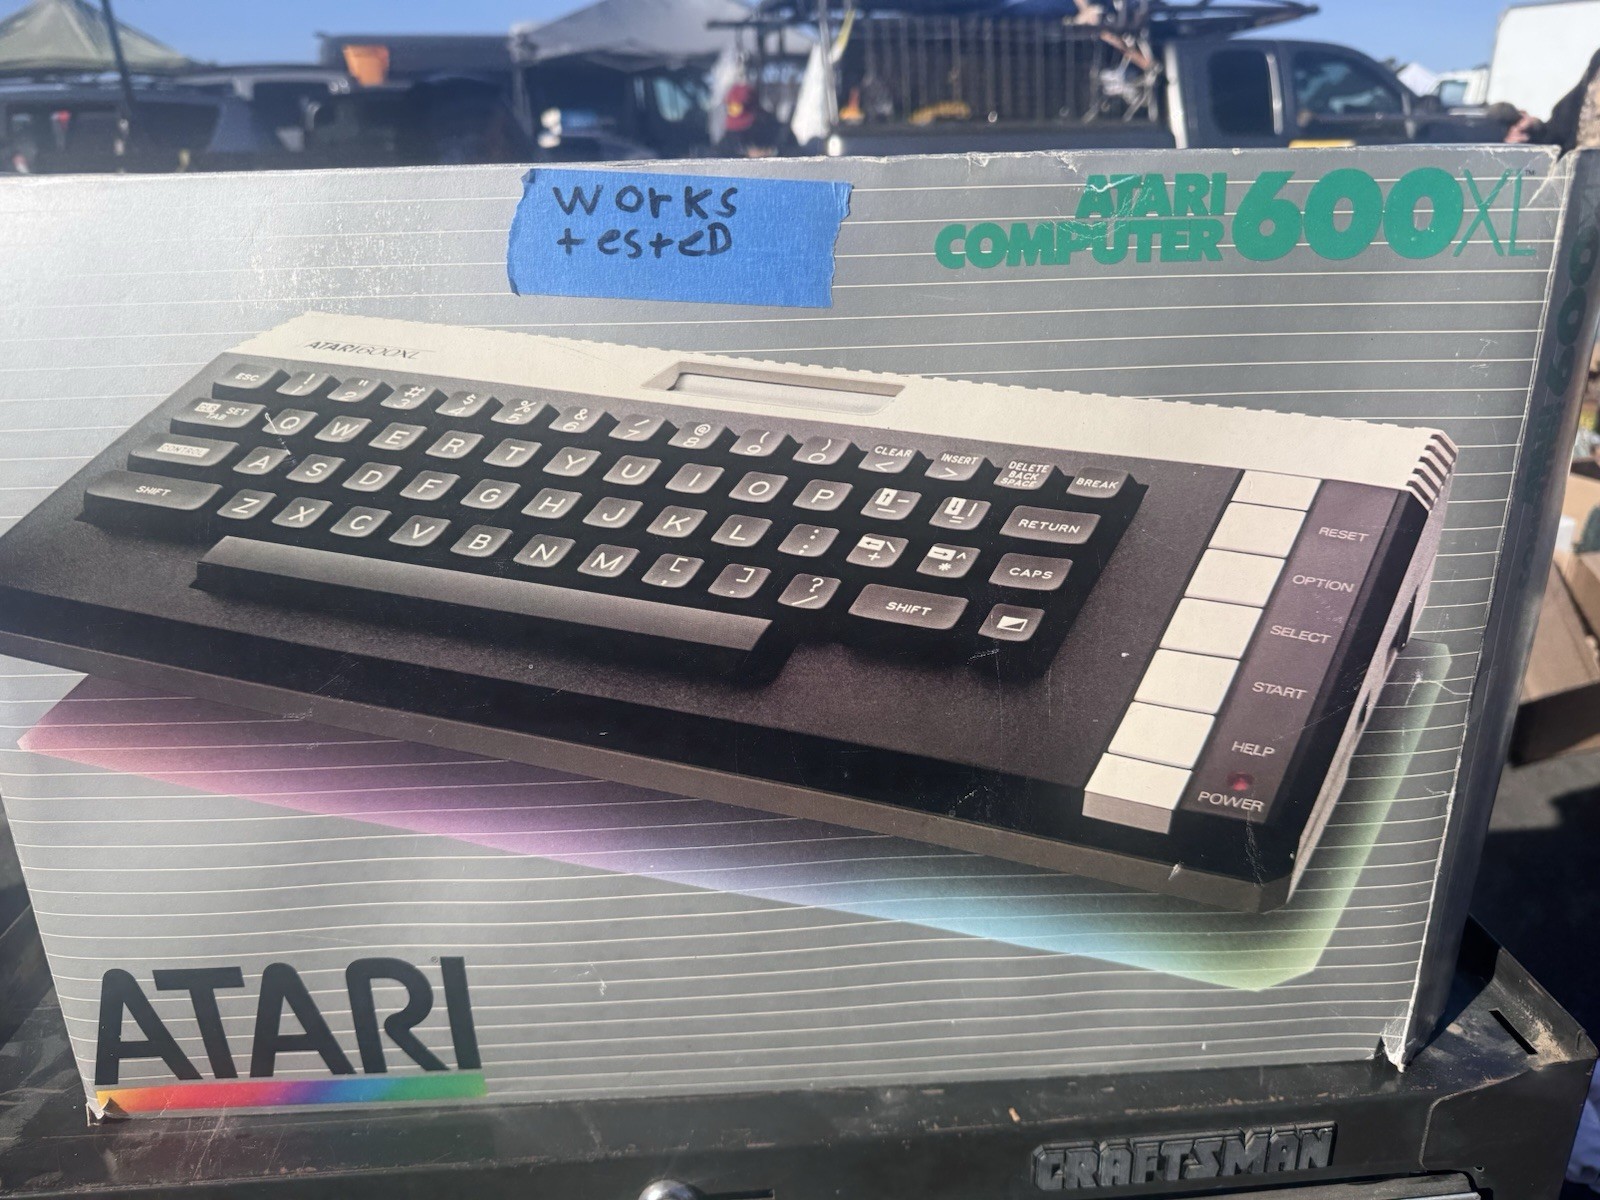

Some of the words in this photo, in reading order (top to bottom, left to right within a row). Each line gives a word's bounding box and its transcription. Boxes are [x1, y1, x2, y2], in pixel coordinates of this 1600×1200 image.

[1076, 173, 1227, 218] ATARI
[935, 218, 1225, 270] COMPUTER
[235, 372, 260, 382] ESC
[404, 386, 427, 398] #
[225, 407, 250, 416] SET
[514, 400, 537, 413] %
[573, 408, 589, 421] &
[280, 416, 301, 430] Q
[331, 421, 358, 437] W
[693, 423, 712, 436] @
[390, 430, 411, 445] E
[441, 437, 465, 453] R
[507, 446, 526, 460] T
[873, 445, 913, 458] CLEAR
[248, 456, 271, 470] A
[564, 454, 587, 470] Y
[940, 453, 980, 466] INSERT
[305, 463, 327, 477] S
[620, 463, 647, 478] U
[1007, 461, 1051, 474] DELETE
[359, 471, 383, 486] D
[999, 478, 1037, 489] SPACE
[1007, 470, 1040, 482] BACK
[1075, 477, 1121, 490] BREAK
[135, 485, 172, 497] SHIFT
[419, 479, 443, 494] F
[480, 488, 501, 503] G
[811, 489, 836, 503] P
[232, 498, 260, 513] Z
[538, 497, 567, 512] H
[288, 506, 316, 522] X
[602, 507, 627, 521] J
[349, 515, 372, 531] C
[662, 515, 692, 532] K
[1018, 518, 1081, 535] RETURN
[413, 523, 436, 539] V
[728, 524, 747, 541] L
[1318, 526, 1369, 542] RESET
[468, 533, 492, 550] B
[530, 543, 558, 561] N
[590, 552, 625, 571] M
[1009, 567, 1054, 580] CAPS
[809, 577, 824, 593] ?
[1292, 574, 1355, 593] OPTION
[885, 601, 933, 616] SHIFT
[1269, 625, 1332, 643] SELECT
[1252, 681, 1308, 700] START
[1231, 741, 1276, 757] HELP
[1197, 791, 1265, 812] POWER
[94, 956, 483, 1086] ATARI
[1031, 1120, 1338, 1191] CRAFTSMAN
